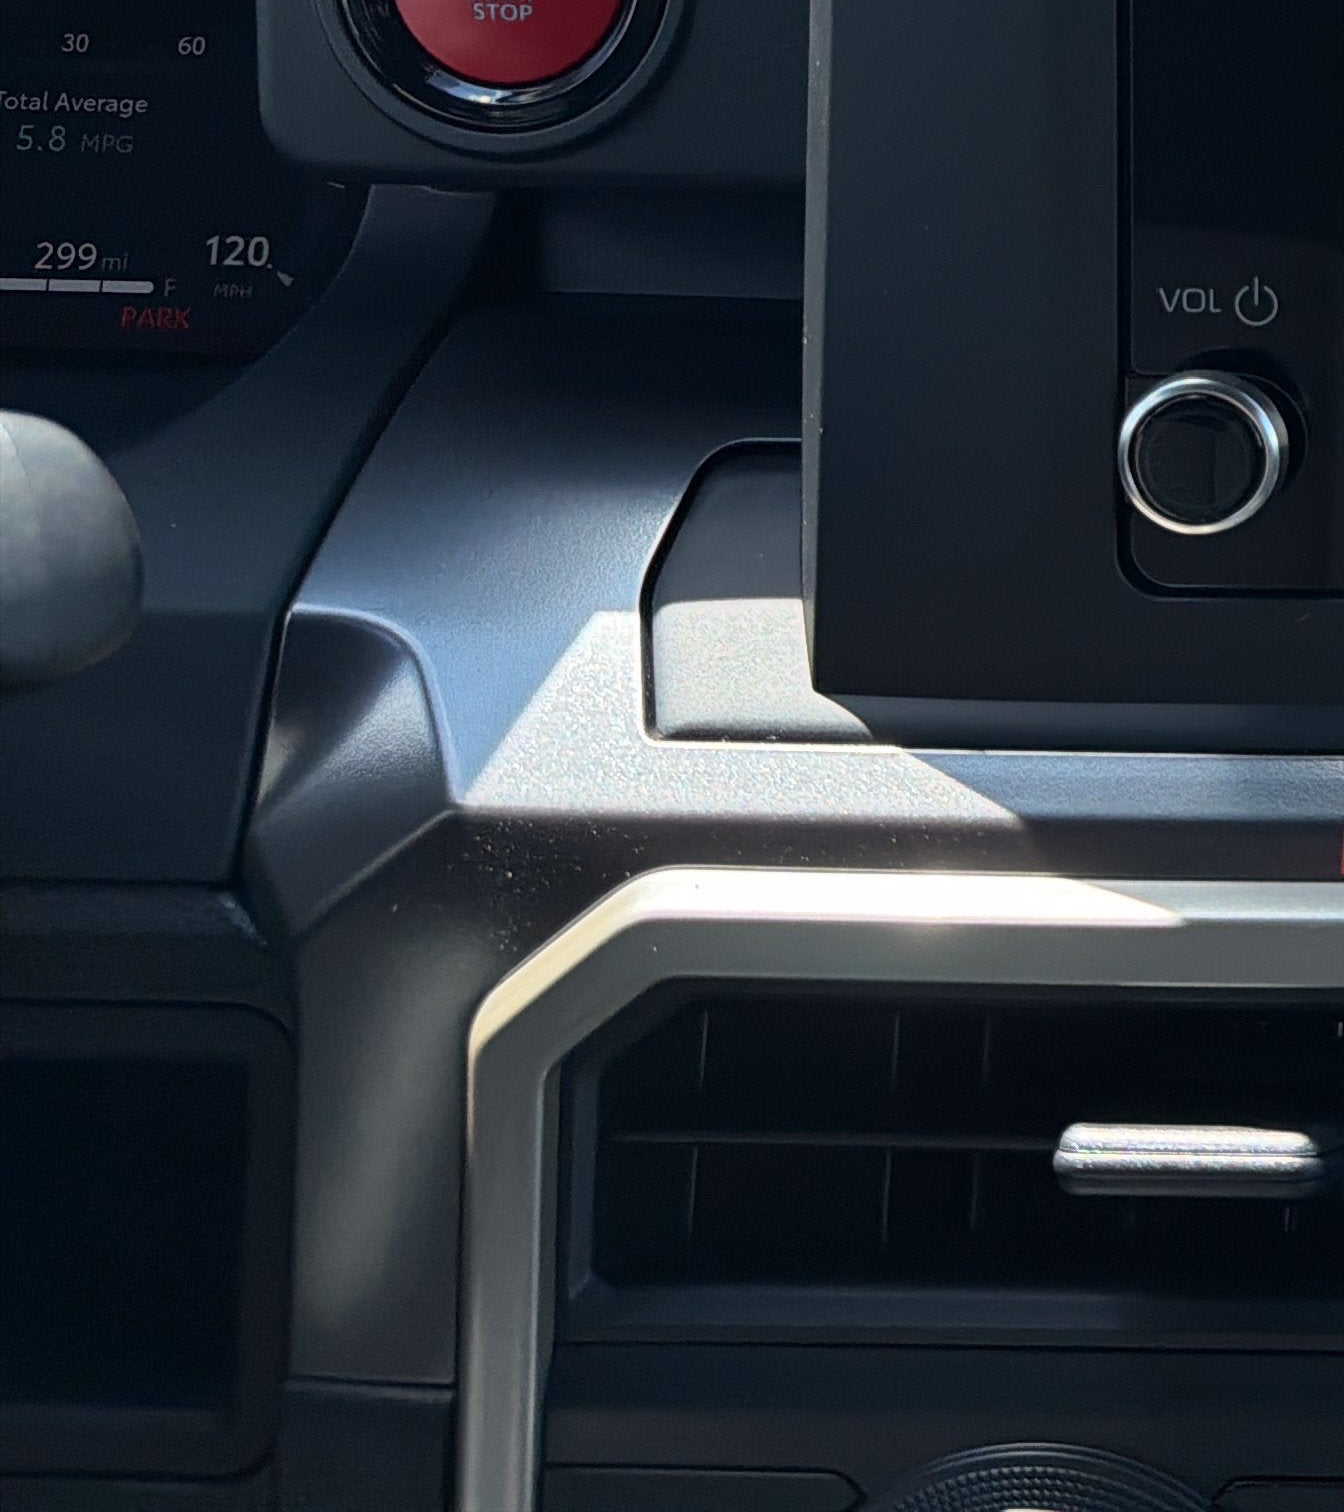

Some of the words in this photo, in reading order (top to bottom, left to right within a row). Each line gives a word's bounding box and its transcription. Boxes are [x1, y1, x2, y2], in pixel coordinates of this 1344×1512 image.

[473, 3, 533, 21] STOP
[61, 34, 89, 52] 30
[178, 37, 206, 55] 60
[54, 93, 148, 118] Average
[16, 124, 66, 151] 5.8
[81, 133, 134, 153] MPG
[34, 242, 97, 270] 299
[102, 253, 128, 271] mi
[205, 235, 270, 266] 120
[1159, 288, 1223, 313] VOL
[122, 306, 192, 328] PARK
